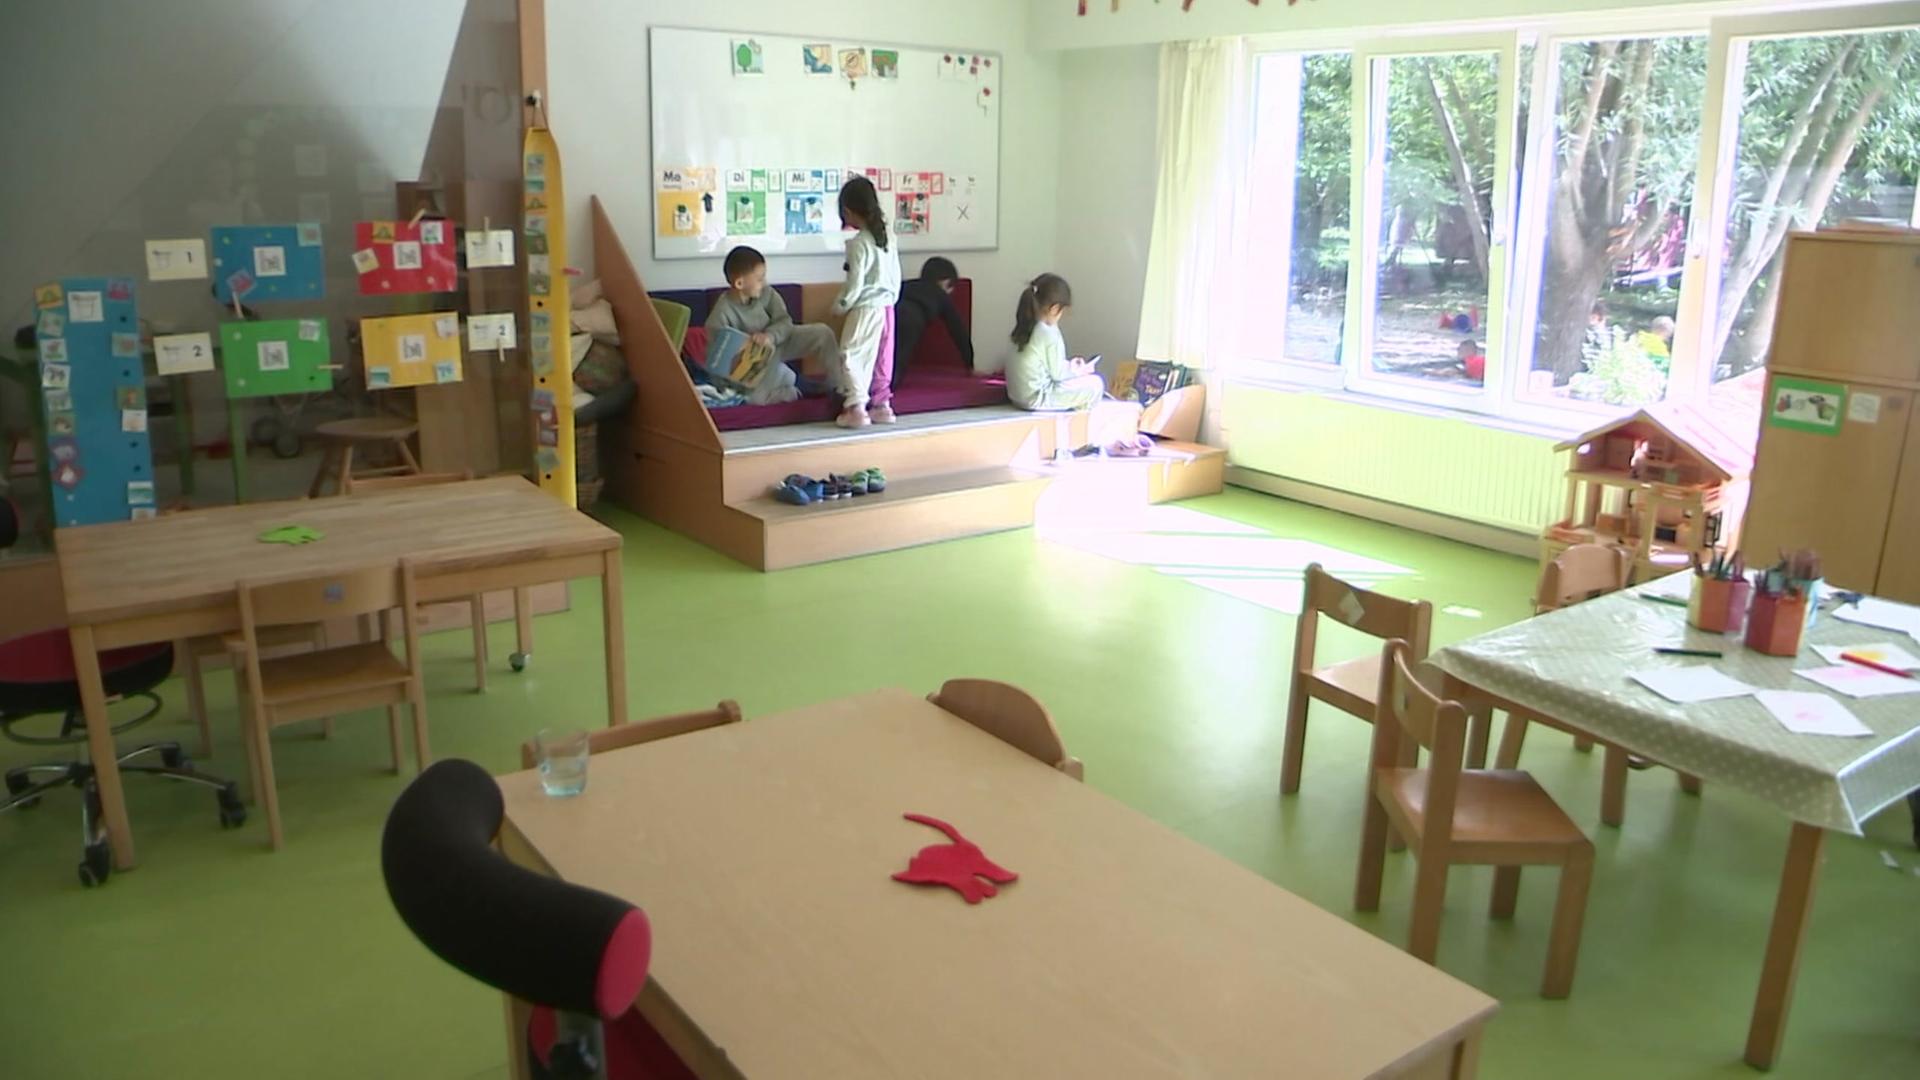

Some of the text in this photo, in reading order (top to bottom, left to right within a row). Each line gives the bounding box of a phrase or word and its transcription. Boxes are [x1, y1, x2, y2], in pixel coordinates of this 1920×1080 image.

[733, 170, 745, 182] Di
[792, 171, 805, 183] Mi
[192, 344, 203, 358] 2
